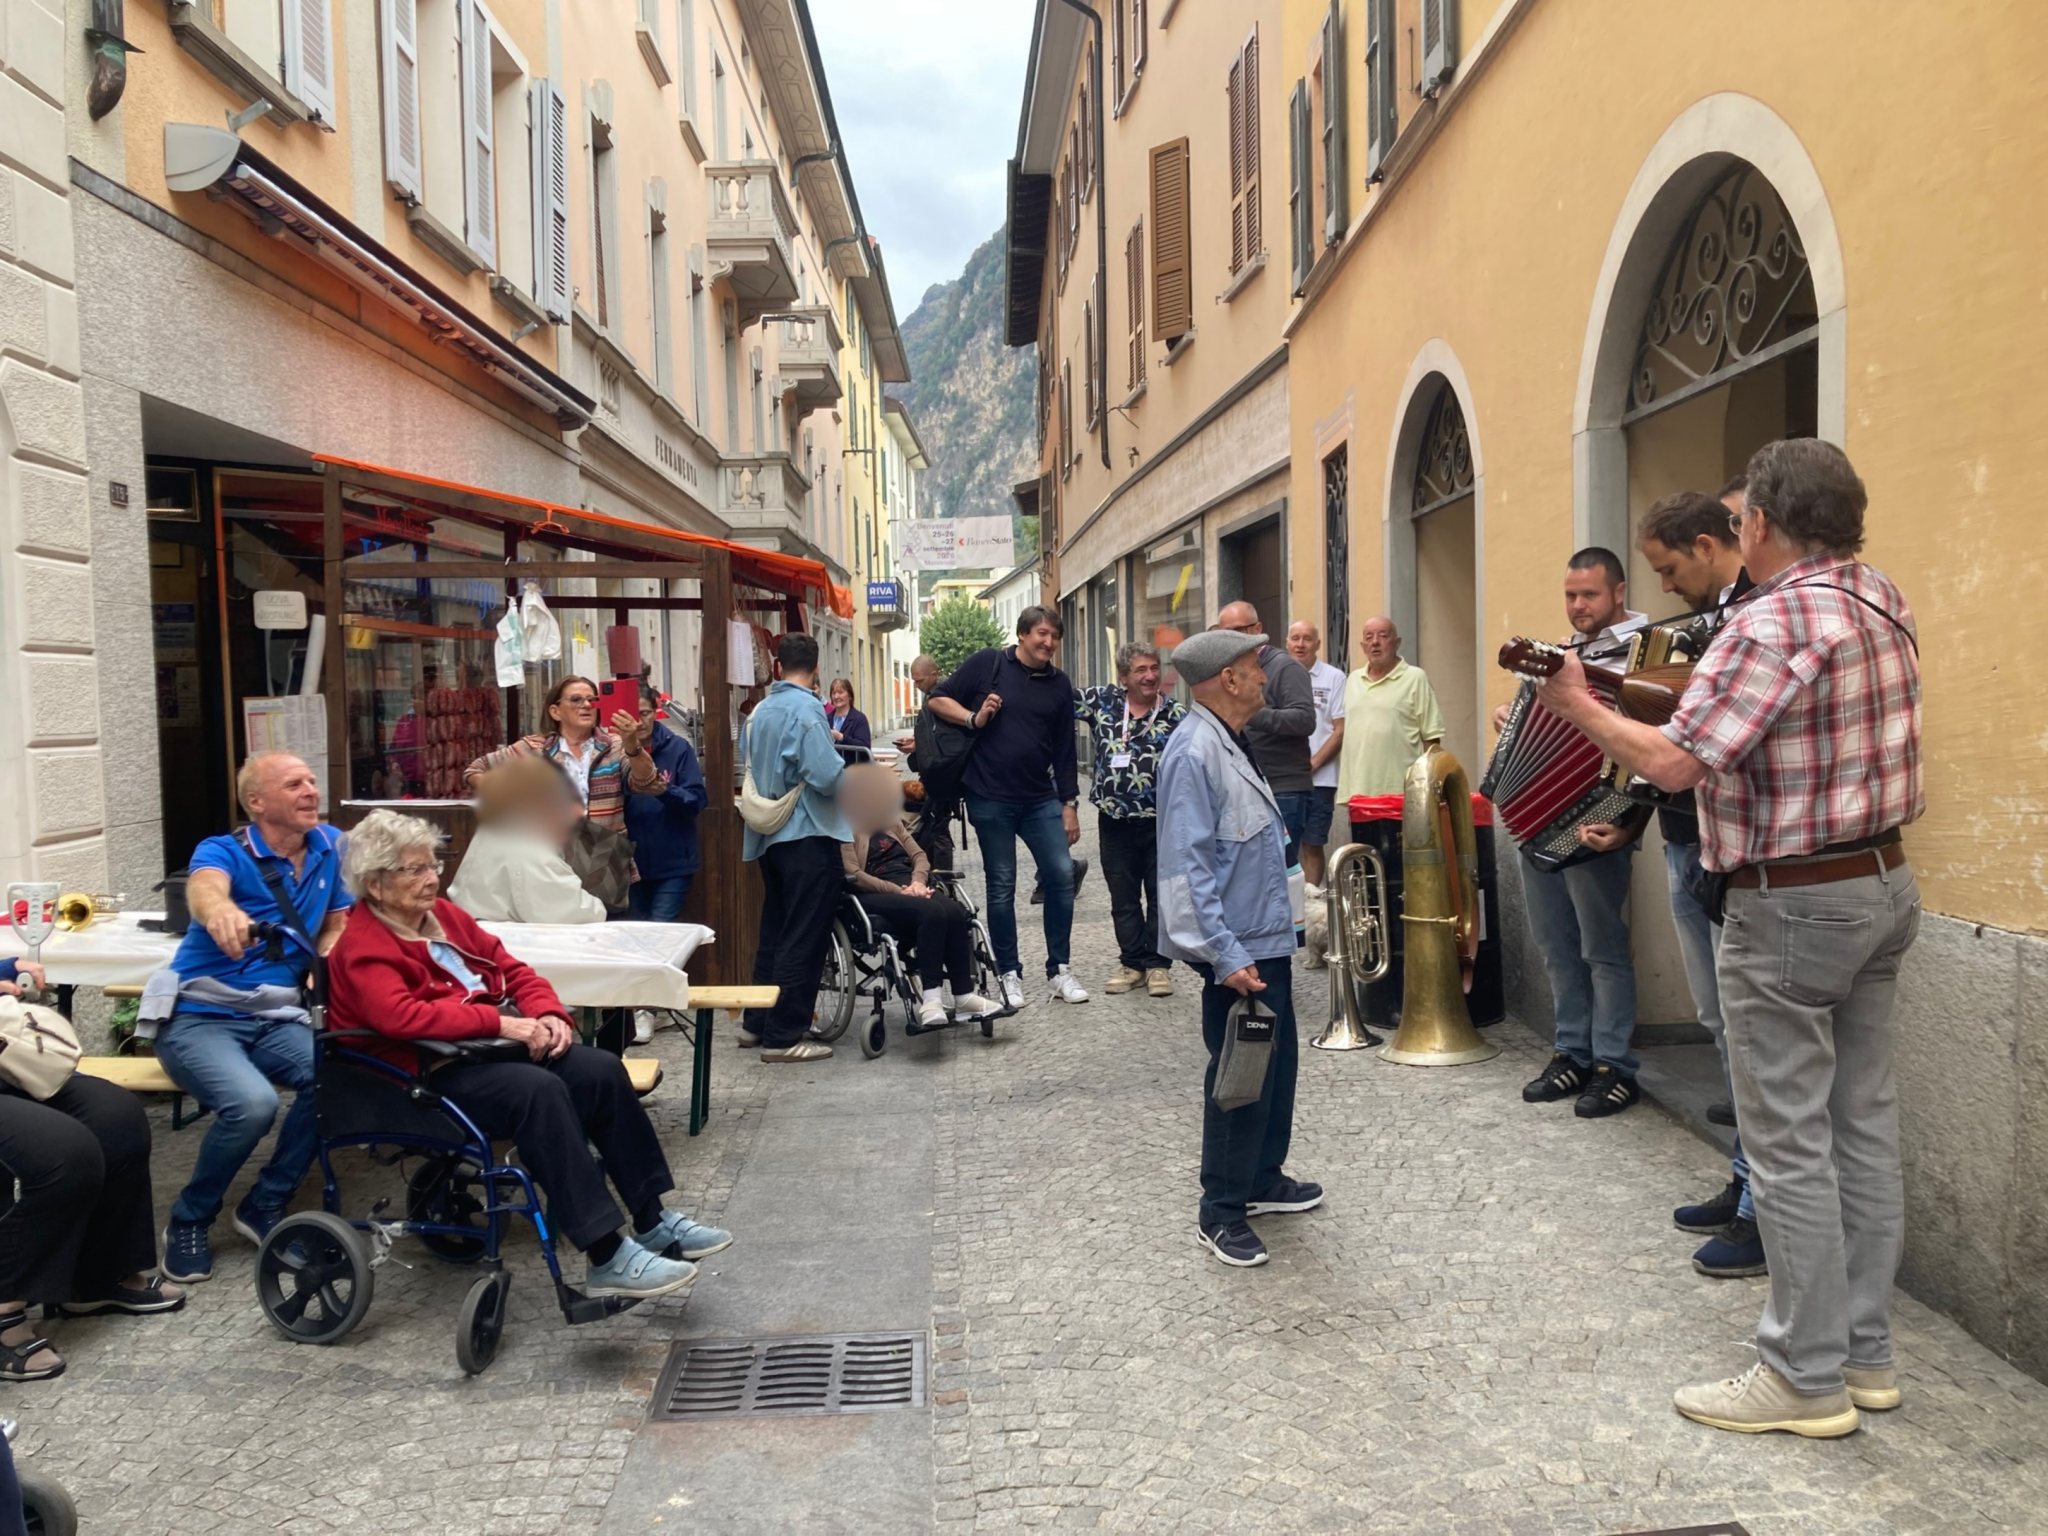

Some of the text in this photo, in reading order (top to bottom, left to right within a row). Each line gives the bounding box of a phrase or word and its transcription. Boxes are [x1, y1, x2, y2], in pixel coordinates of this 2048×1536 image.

[655, 434, 698, 488] FERRAMENTA
[916, 522, 954, 530] Benvenuti
[869, 586, 893, 596] RIVA
